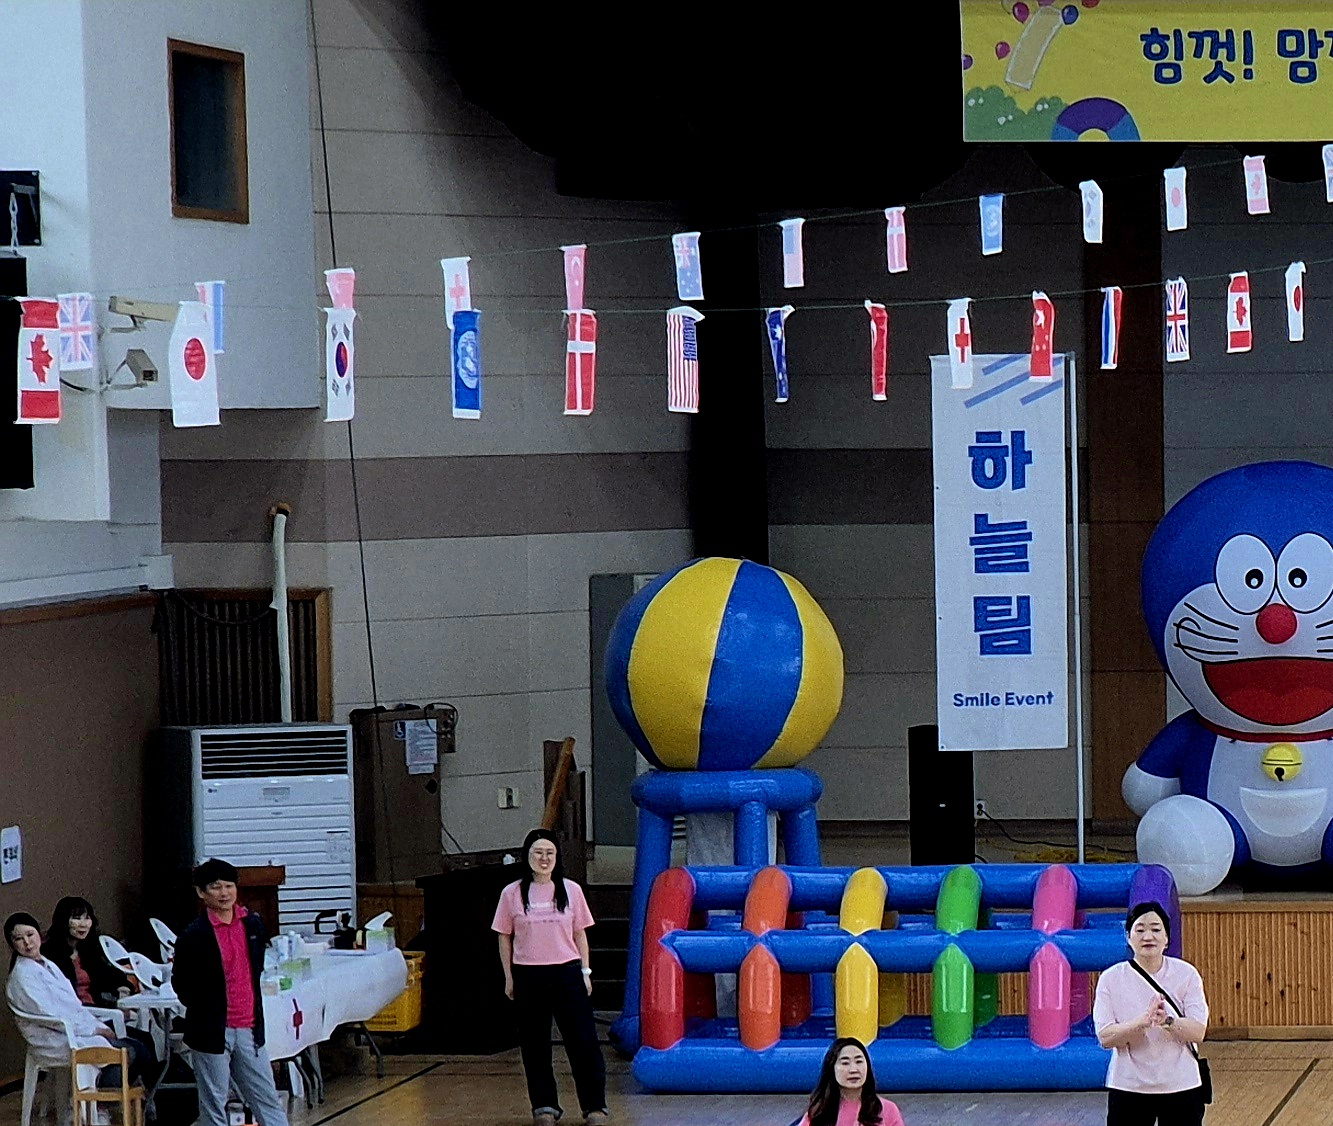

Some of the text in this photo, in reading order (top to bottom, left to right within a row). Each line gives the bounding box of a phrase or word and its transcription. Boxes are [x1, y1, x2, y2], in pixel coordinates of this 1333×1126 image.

[1140, 27, 1254, 85] 힘껏!
[967, 429, 1034, 656] 하늘팀
[953, 690, 1054, 707] Smile Event
